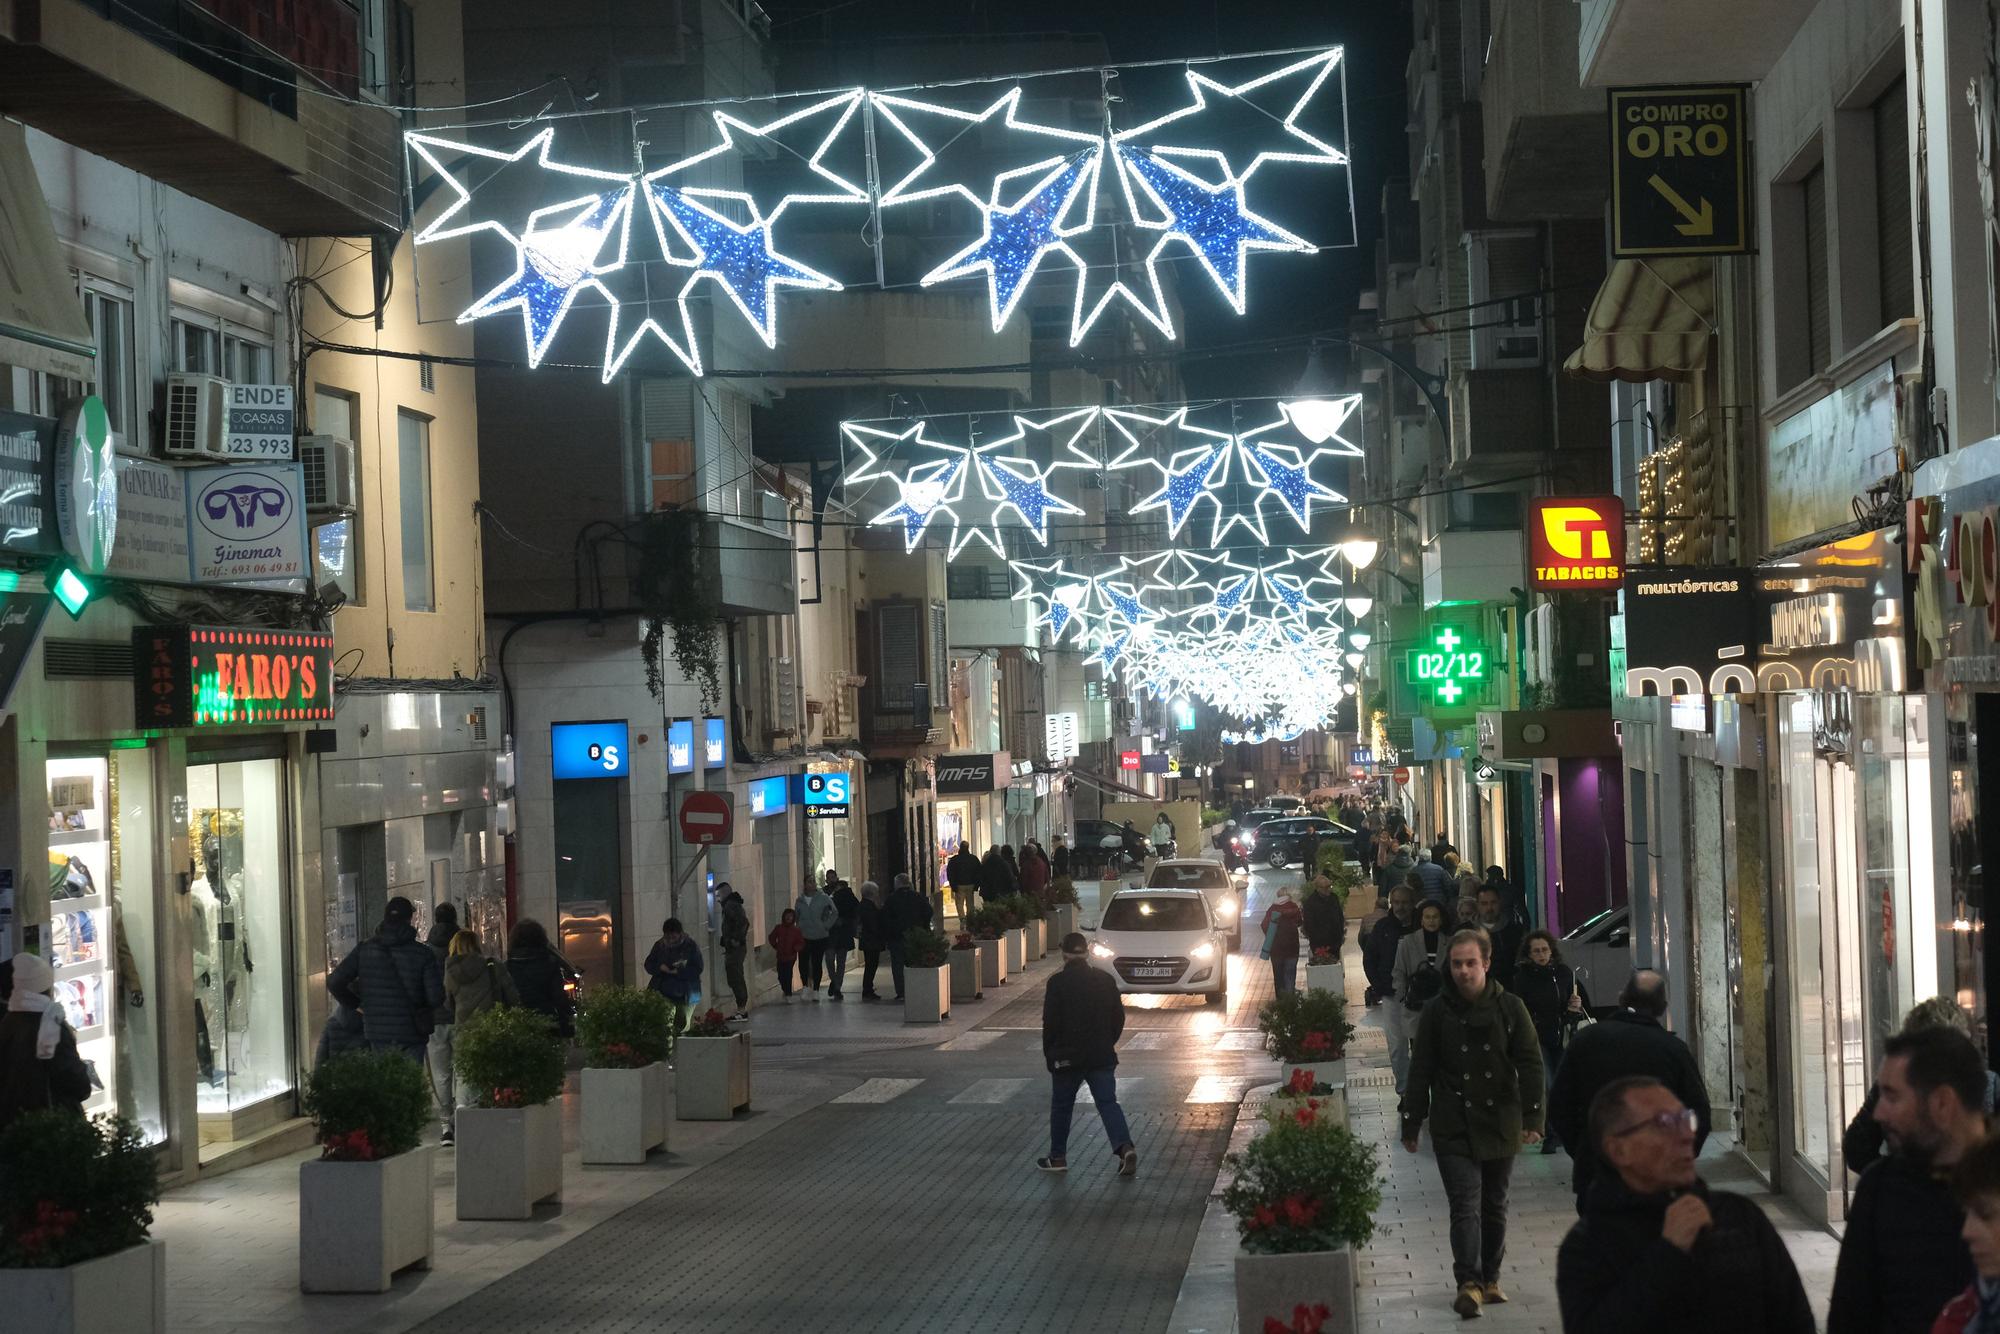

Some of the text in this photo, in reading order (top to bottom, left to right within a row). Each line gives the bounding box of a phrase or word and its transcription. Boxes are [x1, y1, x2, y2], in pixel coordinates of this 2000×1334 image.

[1626, 104, 1729, 122] COMPRO
[1627, 124, 1728, 158] ORO
[230, 387, 286, 405] ENDE
[231, 412, 285, 424] OCASAS
[259, 439, 290, 454] 993
[124, 467, 170, 499] GINEMAR
[213, 545, 282, 564] Ginemar
[231, 565, 250, 575] 693
[253, 564, 266, 574] 06
[269, 563, 282, 573] 49
[285, 562, 297, 573] 81
[1536, 566, 1619, 580] TABACOS
[1417, 653, 1483, 678] 02/12
[214, 653, 317, 700] FARO'S
[1354, 752, 1371, 762] LLA
[936, 766, 990, 782] IMAS
